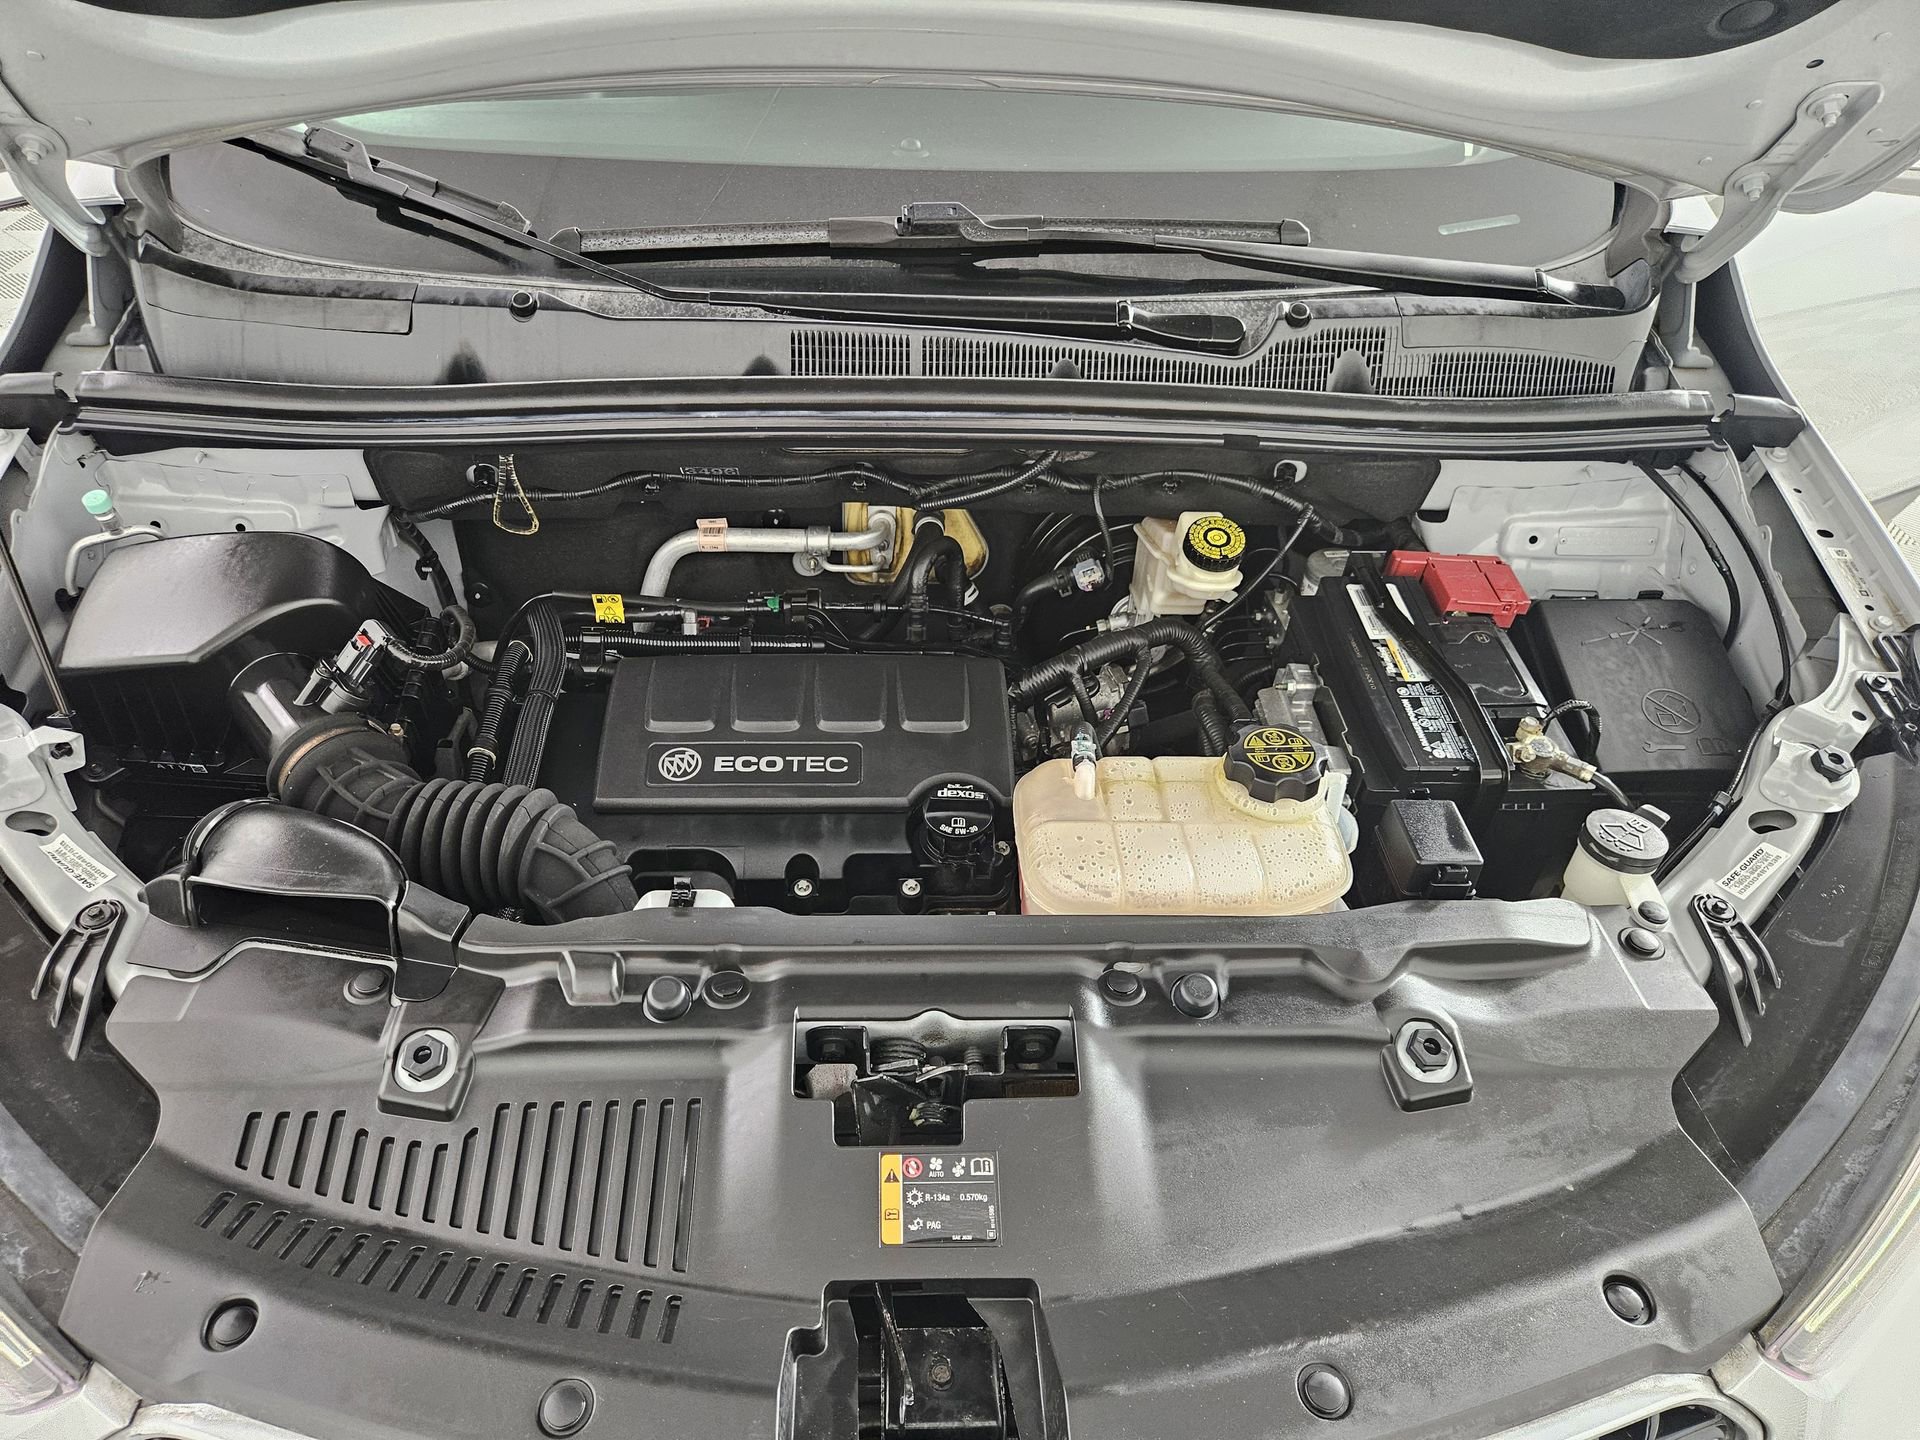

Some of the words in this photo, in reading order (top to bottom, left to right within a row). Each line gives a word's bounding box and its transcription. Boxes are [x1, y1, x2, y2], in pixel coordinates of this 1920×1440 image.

[713, 756, 849, 772] ECOTEC
[937, 788, 985, 799] dexos
[939, 824, 953, 834] SAE
[955, 825, 978, 834] 5W-30
[925, 1193, 951, 1202] R-134a
[960, 1193, 988, 1203] 0.570kg
[926, 1221, 942, 1230] PAG
